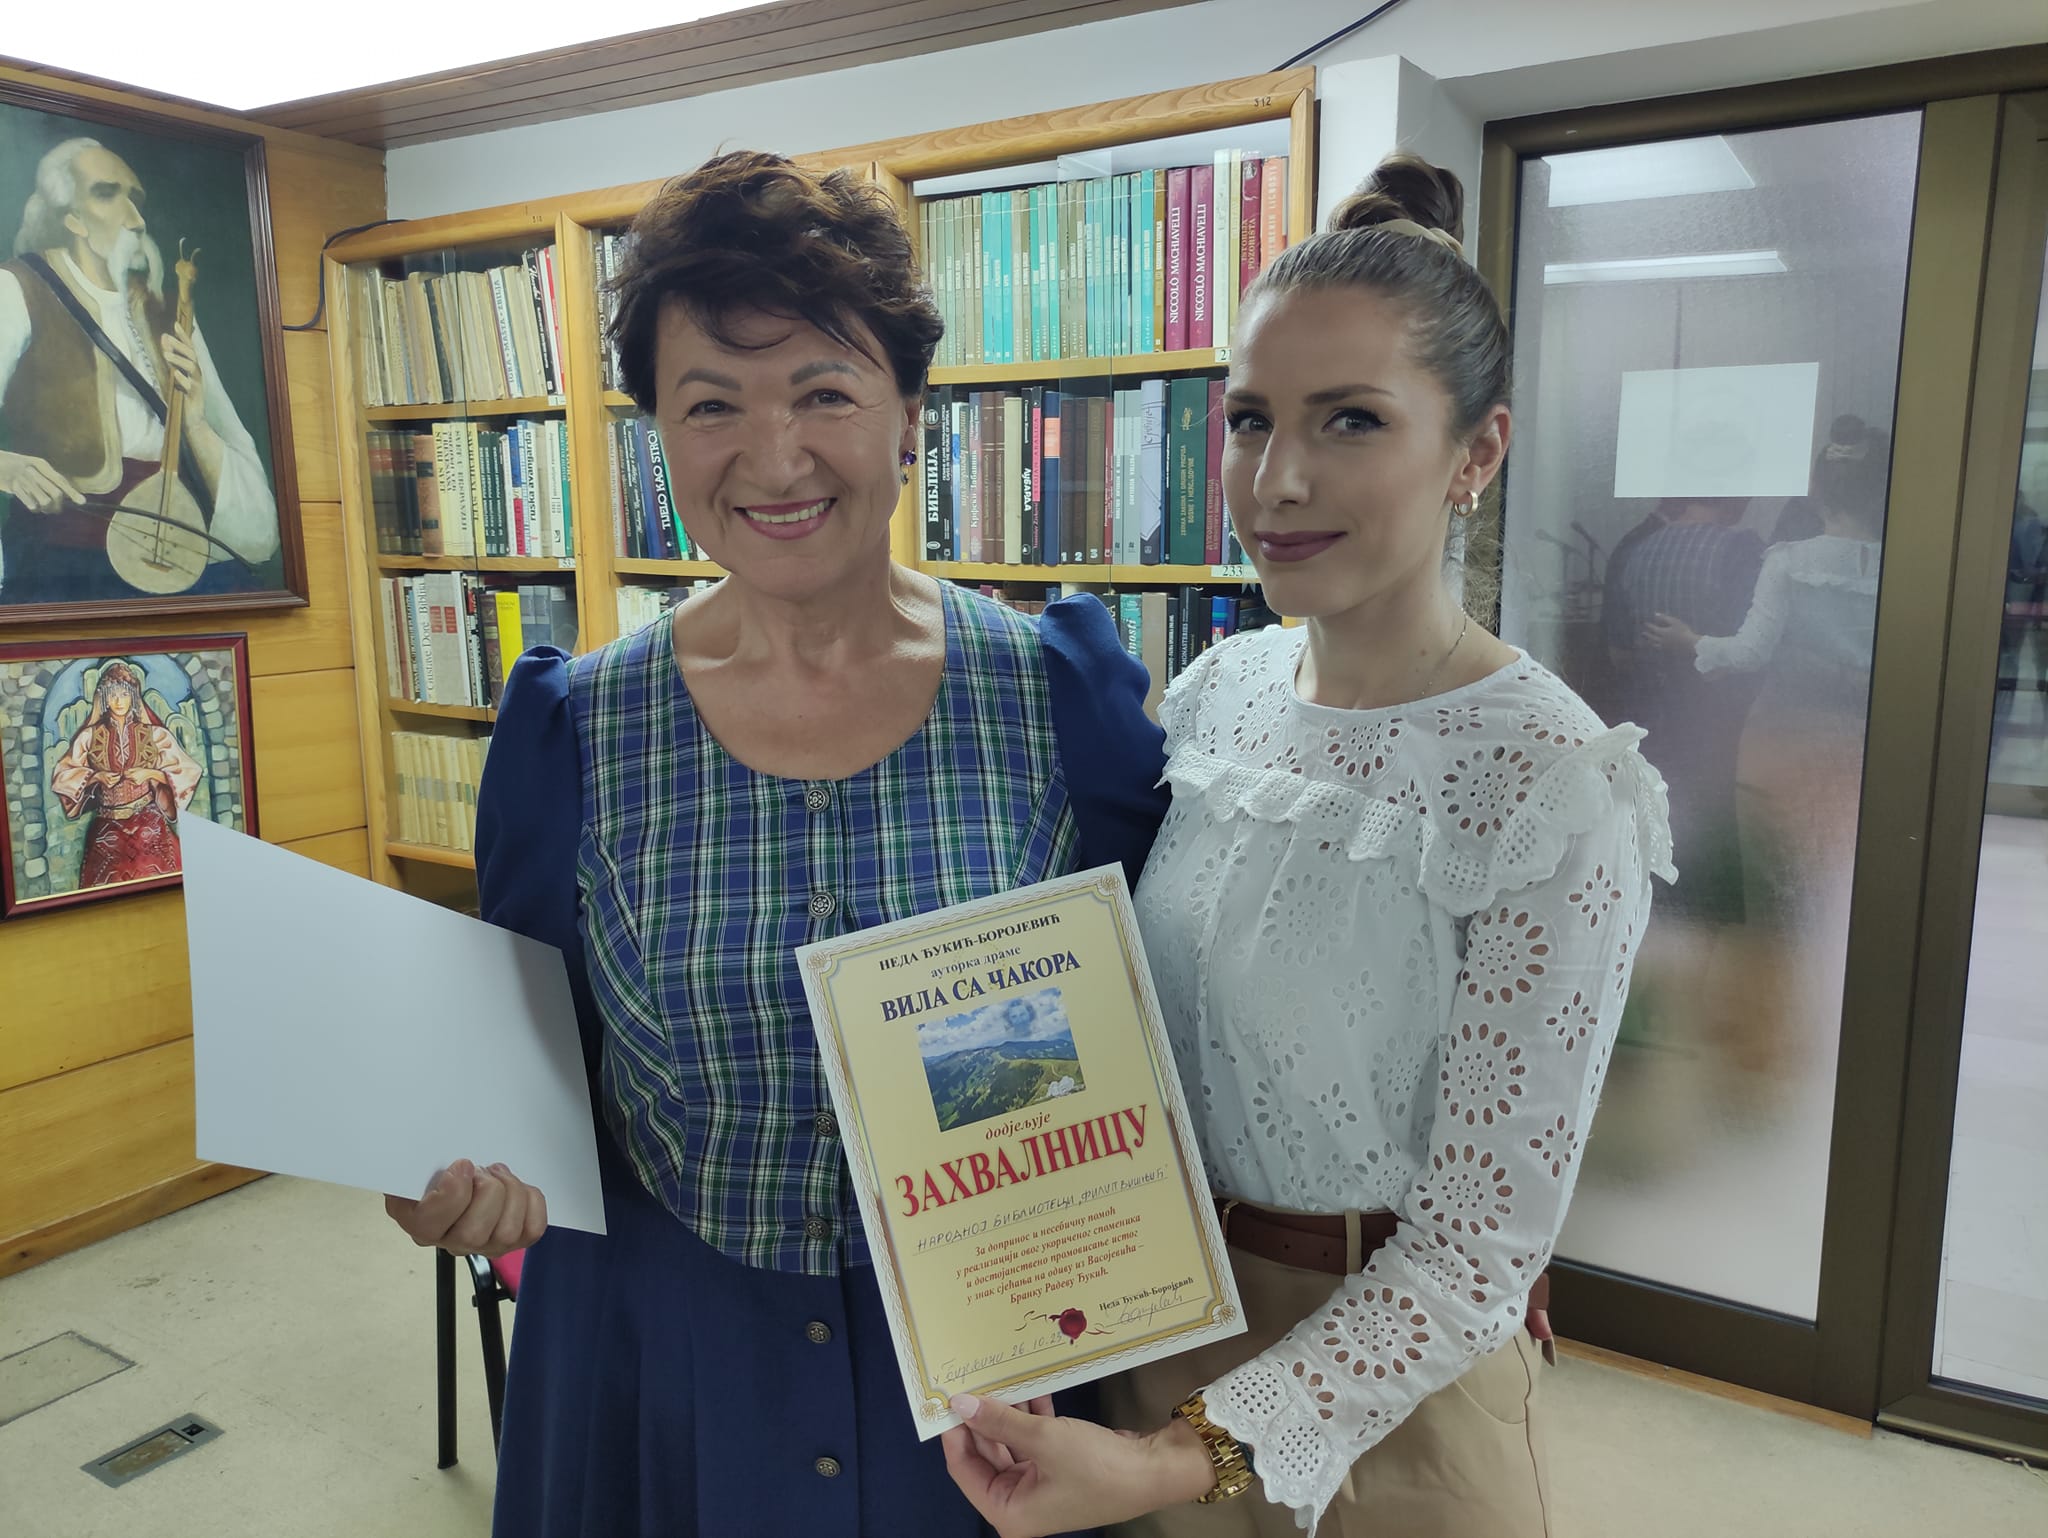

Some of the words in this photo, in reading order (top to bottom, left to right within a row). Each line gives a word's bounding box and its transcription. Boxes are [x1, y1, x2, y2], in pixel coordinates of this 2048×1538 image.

[1170, 207, 1180, 274] MACHIAVELLI
[1196, 204, 1206, 272] MACHIAVELLI
[1169, 278, 1178, 323] NICCOLÒ
[1195, 275, 1204, 320] NICCOLÒ
[525, 431, 534, 488] avangarda
[647, 430, 659, 464] STROJ
[653, 465, 664, 492] KAO
[927, 447, 939, 522] БИБЛИЈА
[528, 491, 537, 521] ruska
[658, 494, 671, 530] TIJELO
[1061, 552, 1067, 562] 1
[1075, 552, 1083, 561] 2
[1090, 548, 1098, 558] 3
[1223, 565, 1243, 576] 233
[1126, 618, 1137, 655] tnosti
[880, 953, 918, 970] НЕДА
[923, 914, 1060, 958] ЂУКИЋ-БОРОЈЕВИЋ
[931, 959, 980, 979] ауторка
[985, 948, 1020, 964] драме
[880, 987, 949, 1021] ВИЛА
[953, 977, 986, 1000] СА
[987, 951, 1080, 989] ЧАКОРА
[986, 1112, 1050, 1139] додјељује
[896, 1104, 1146, 1216] ЗАХВАЛНИЦУ
[918, 1220, 991, 1251] НАРОДНОЈ
[993, 1195, 1077, 1227] БИБЛИОТЕЦИ
[976, 1247, 985, 1256] За
[988, 1234, 1029, 1252] допринос
[1041, 1217, 1085, 1236] несебичну
[1088, 1206, 1115, 1222] помоћ
[957, 1270, 961, 1279] у
[964, 1251, 1018, 1277] реализацији
[1021, 1245, 1043, 1256] овог
[1042, 1230, 1090, 1253] укориченог
[1094, 1216, 1140, 1234] споменика
[975, 1257, 1048, 1285] достојанствено
[1051, 1239, 1109, 1263] промовисање
[1112, 1230, 1138, 1244] истог
[968, 1296, 972, 1305] у
[976, 1288, 994, 1299] знак
[997, 1277, 1032, 1294] сјећања
[1048, 1264, 1072, 1277] одиву
[1076, 1261, 1084, 1269] из
[1088, 1245, 1136, 1265] Васојевића
[1011, 1288, 1042, 1304] Бранку
[1046, 1278, 1074, 1293] Радеву
